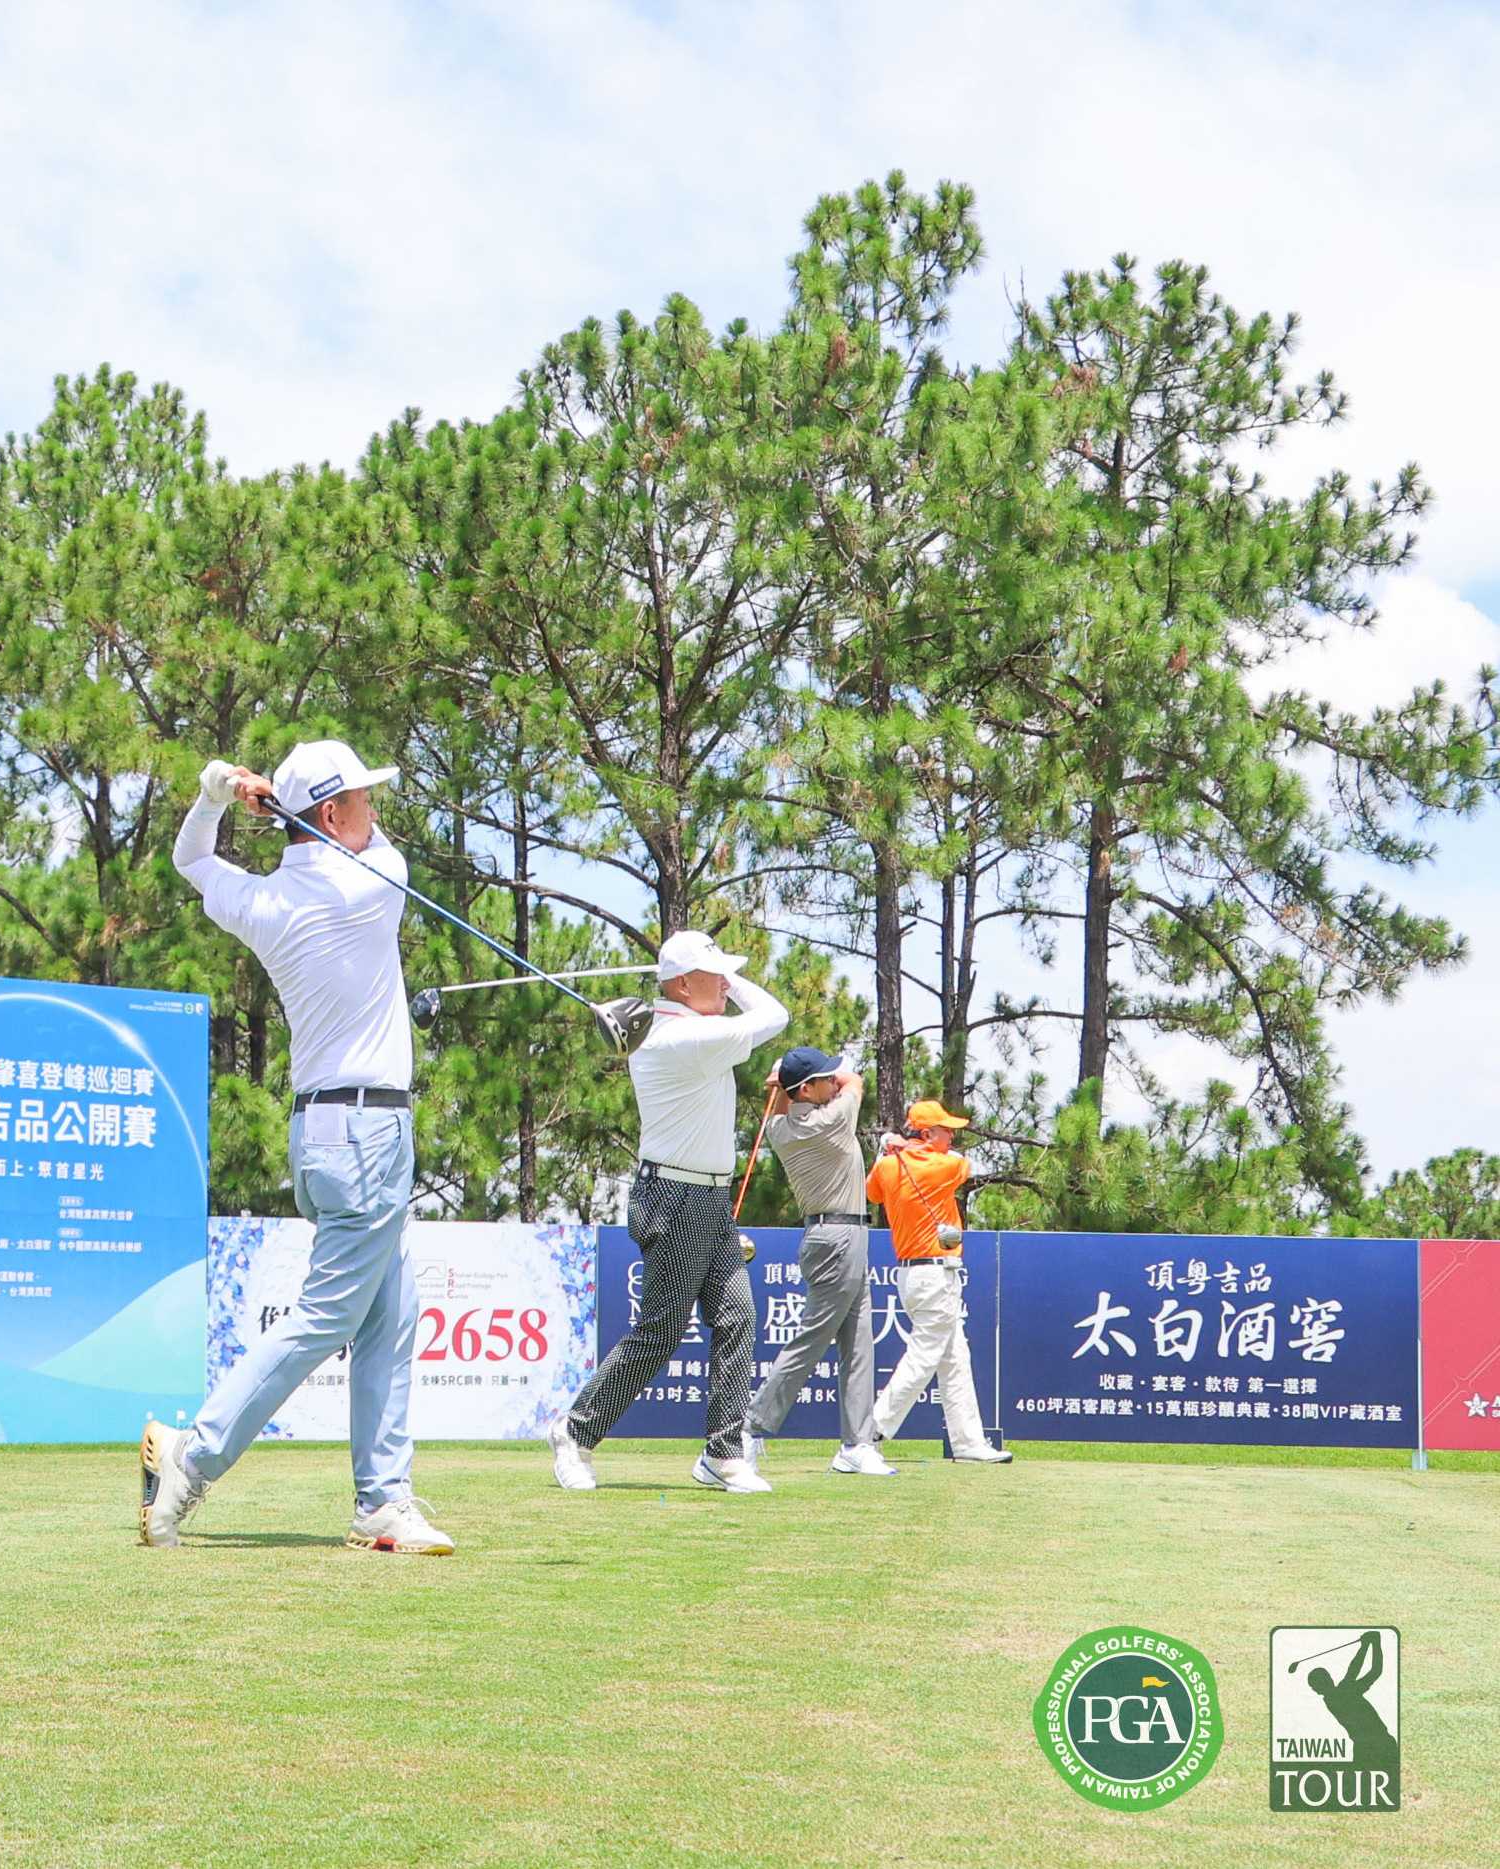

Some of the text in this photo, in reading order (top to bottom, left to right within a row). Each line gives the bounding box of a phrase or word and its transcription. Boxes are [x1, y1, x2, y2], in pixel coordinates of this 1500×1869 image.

[1143, 1259, 1273, 1297] 頂粵吉品
[417, 1307, 549, 1363] 2658
[1071, 1290, 1346, 1364] 太白酒窖
[1248, 1376, 1318, 1395] 第一選擇
